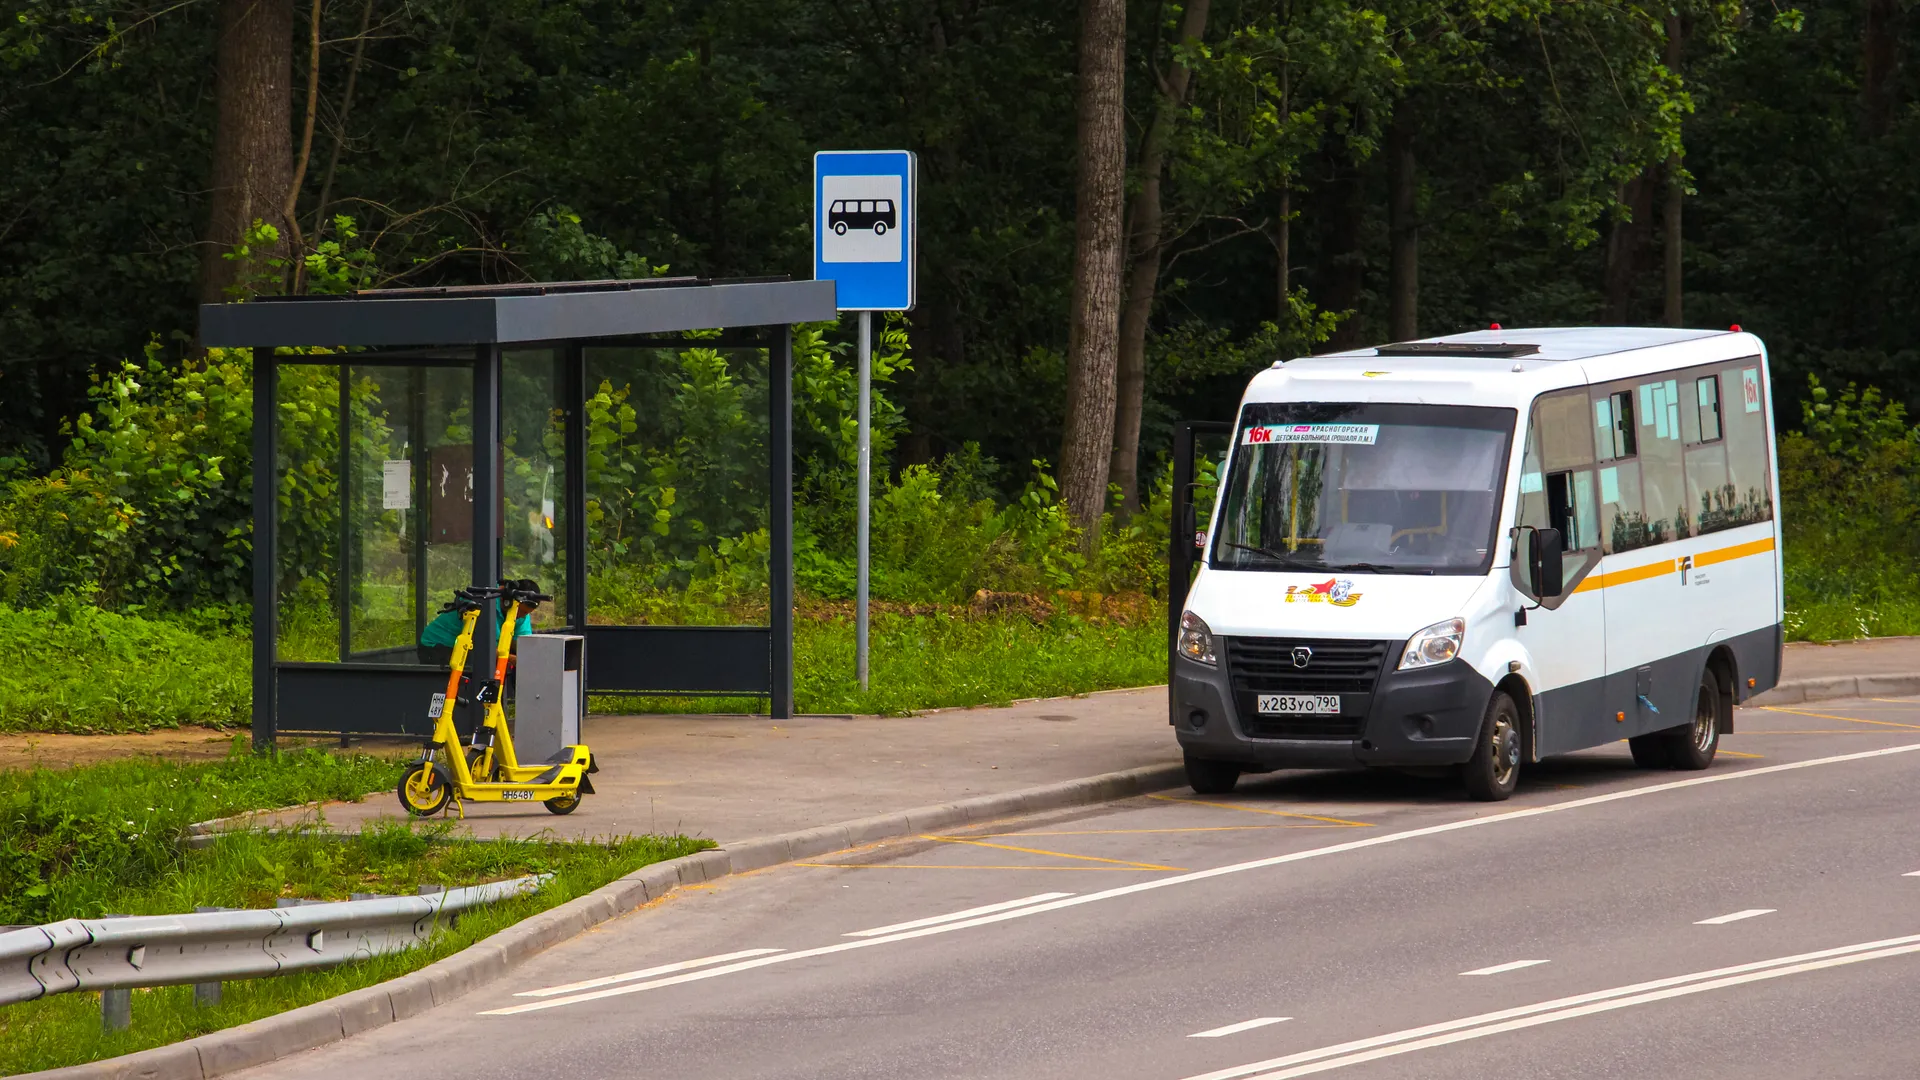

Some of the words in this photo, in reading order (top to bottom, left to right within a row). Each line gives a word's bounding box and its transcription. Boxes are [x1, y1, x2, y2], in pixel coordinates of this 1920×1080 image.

[1275, 434, 1301, 442] ДЕТСКАЯ
[1300, 434, 1330, 442] БОЛЬНИЦА
[1316, 696, 1337, 708] 790
